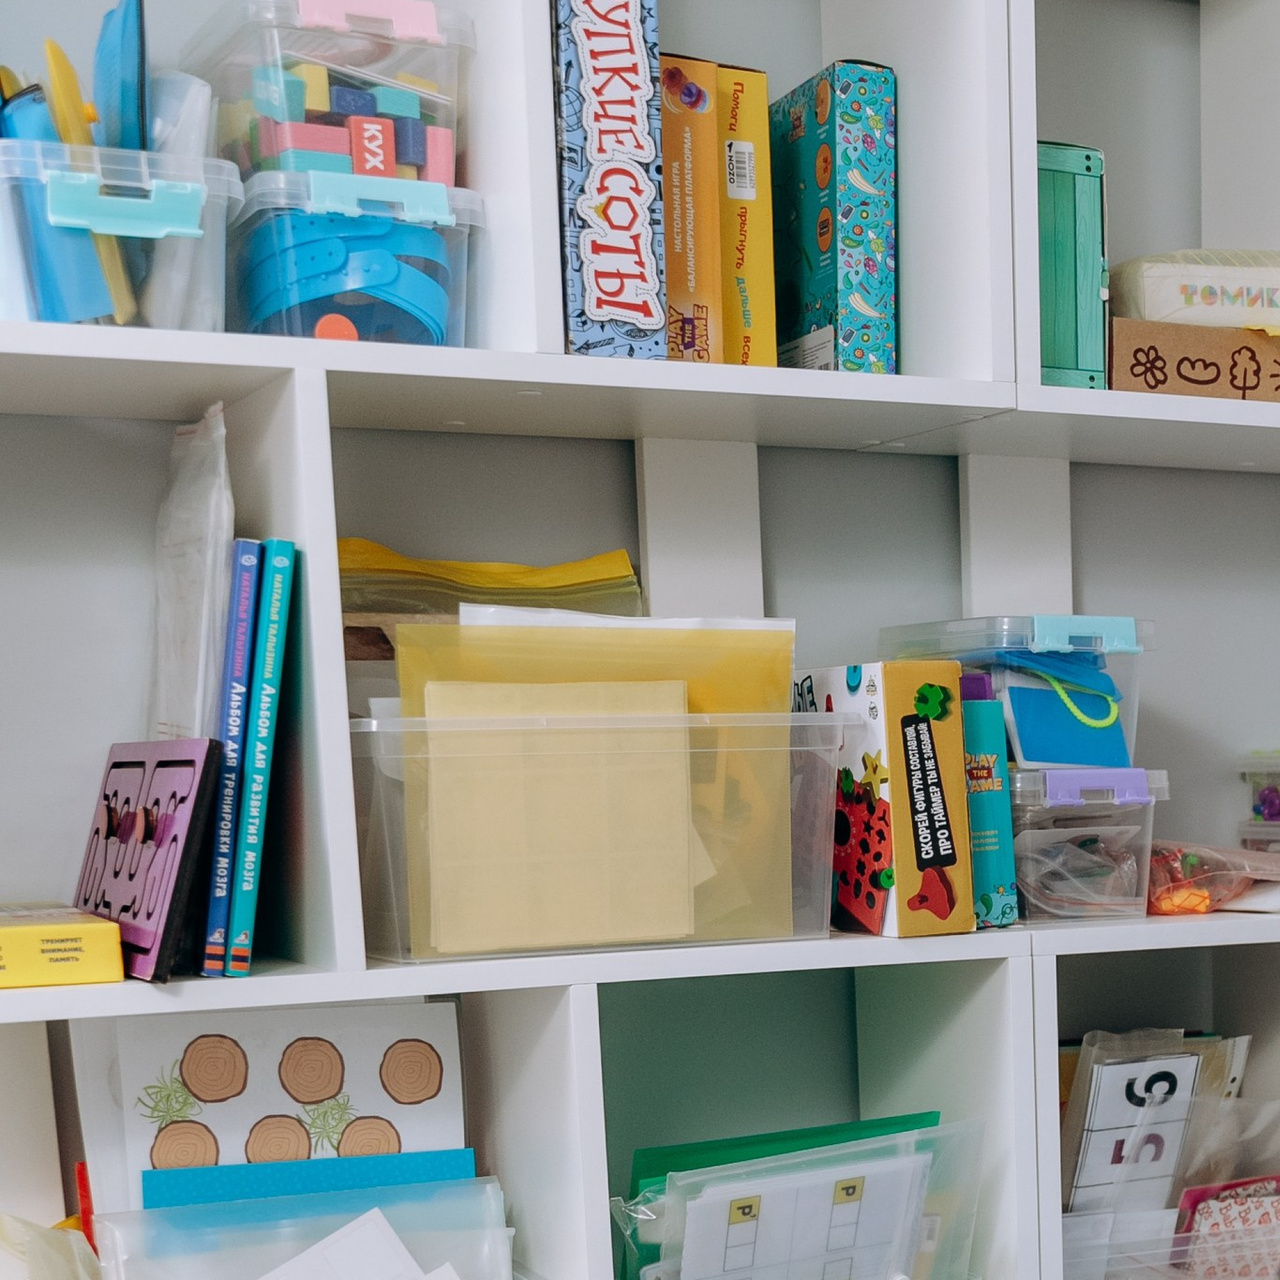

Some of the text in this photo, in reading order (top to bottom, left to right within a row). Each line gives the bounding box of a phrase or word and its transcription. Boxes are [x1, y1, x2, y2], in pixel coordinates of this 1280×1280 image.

[728, 81, 745, 132] Помоги
[362, 123, 385, 172] КУХ
[672, 161, 683, 253] НАСТОЛЬНАЯ ИГРА
[590, 167, 655, 319] СОТЫ
[735, 206, 748, 270] прыгнуть
[735, 276, 752, 329] дальше
[1179, 283, 1280, 310] ТОМИК
[668, 304, 685, 357] PLAY
[684, 323, 693, 346] THE
[693, 304, 709, 363] GAME
[924, 758, 936, 770] НЕ
[927, 771, 938, 785] ТЫ
[970, 777, 1003, 793] AME
[972, 769, 988, 777] THE
[912, 772, 926, 811] ФИГУРЫ
[929, 786, 946, 828] ТАЙМЕР
[915, 812, 934, 859] СКОРЕЙ
[936, 829, 953, 856] ПРО
